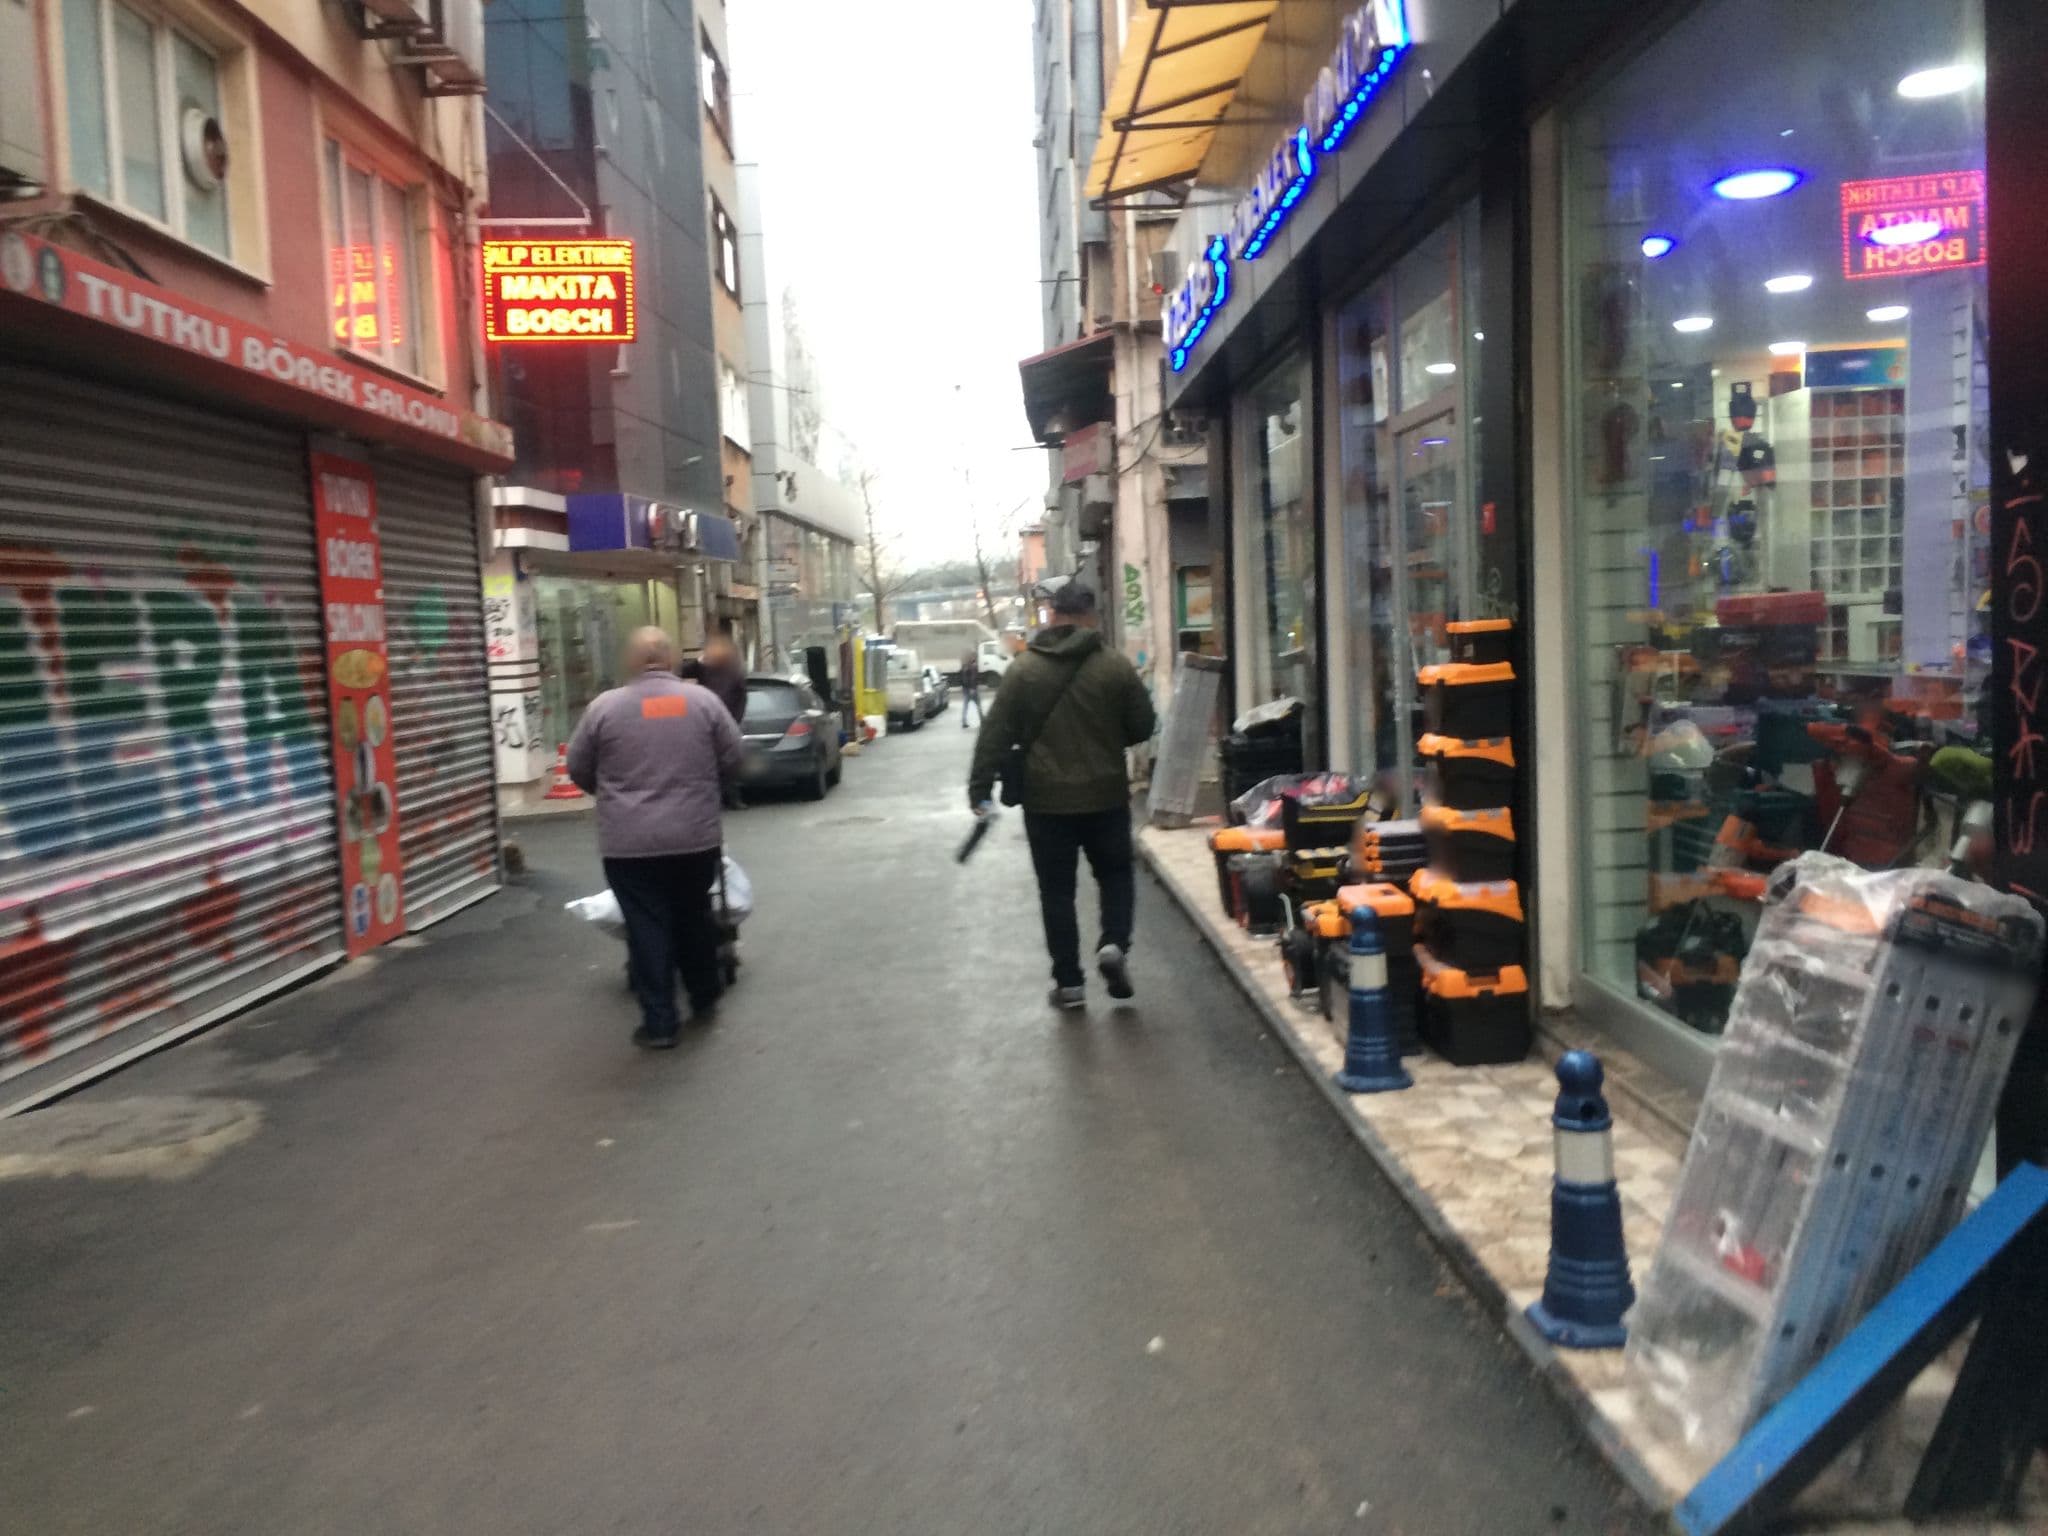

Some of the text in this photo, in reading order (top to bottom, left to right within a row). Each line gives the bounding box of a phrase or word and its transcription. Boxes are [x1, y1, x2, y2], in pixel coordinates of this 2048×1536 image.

[501, 275, 617, 300] MAKITA
[506, 308, 613, 333] BOSCH
[75, 272, 458, 437] TUTKU BÖREK SALONU
